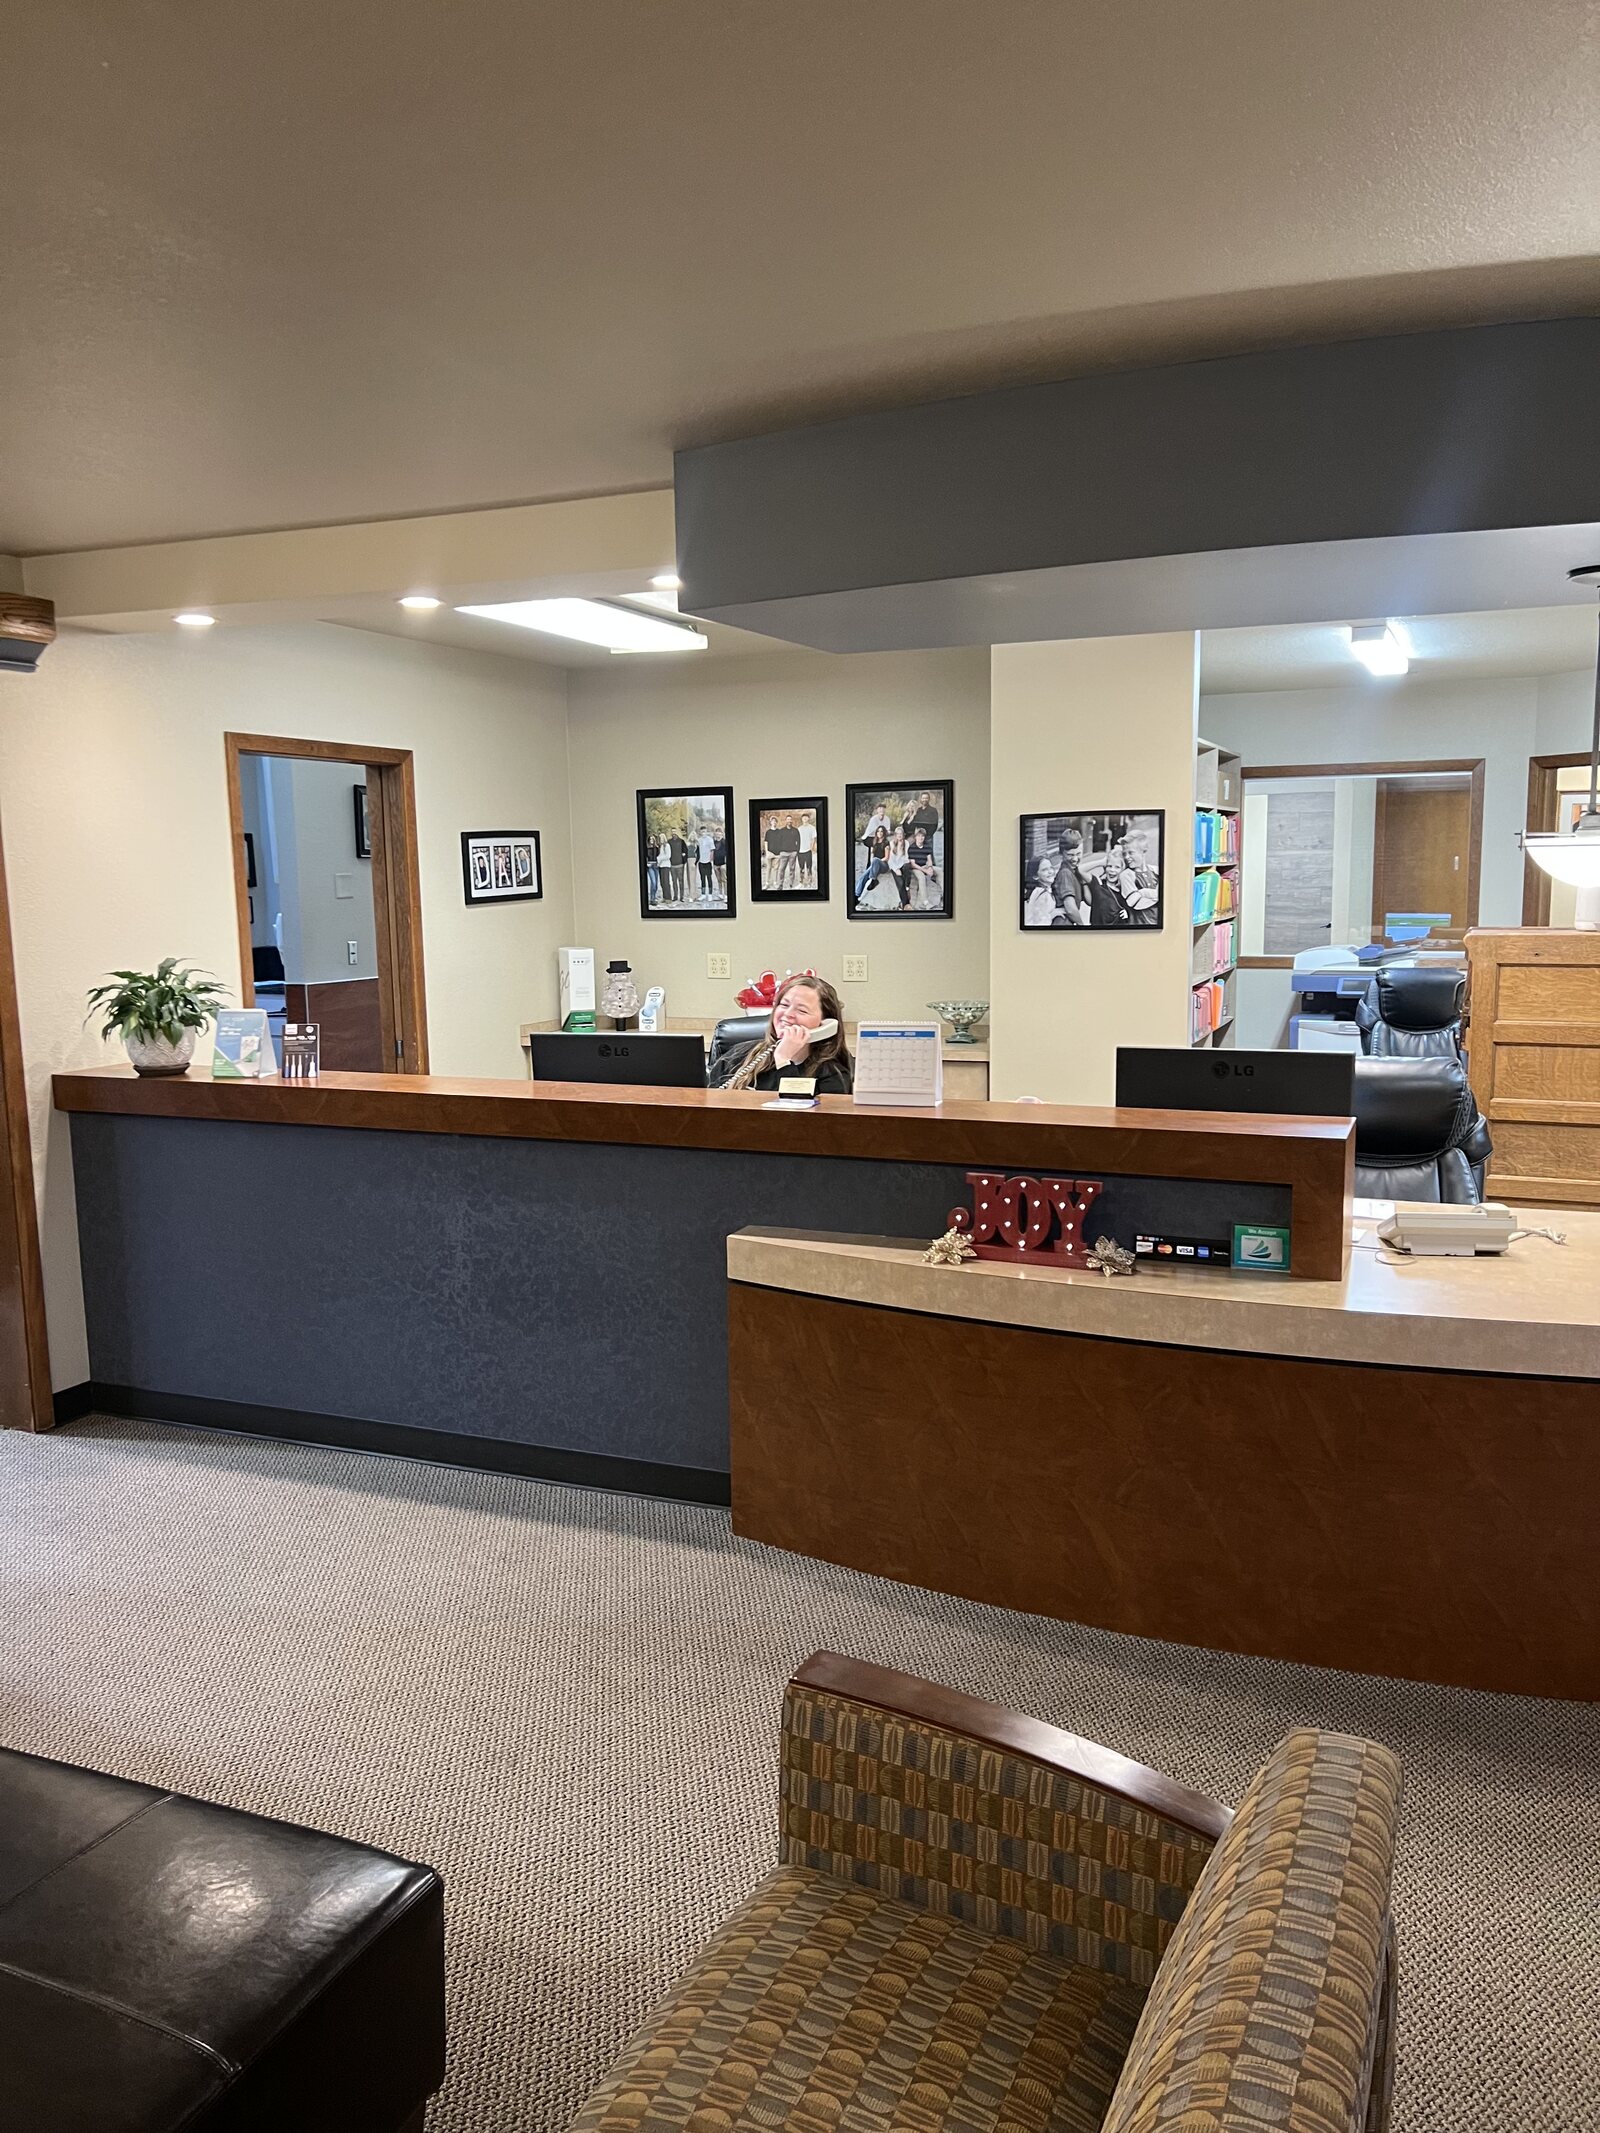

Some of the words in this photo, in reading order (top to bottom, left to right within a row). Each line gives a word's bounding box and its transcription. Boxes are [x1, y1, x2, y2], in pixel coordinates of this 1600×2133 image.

[473, 847, 530, 888] DAD
[614, 1047, 630, 1057] LG
[1234, 1065, 1254, 1076] LG
[947, 1172, 1104, 1253] JOY
